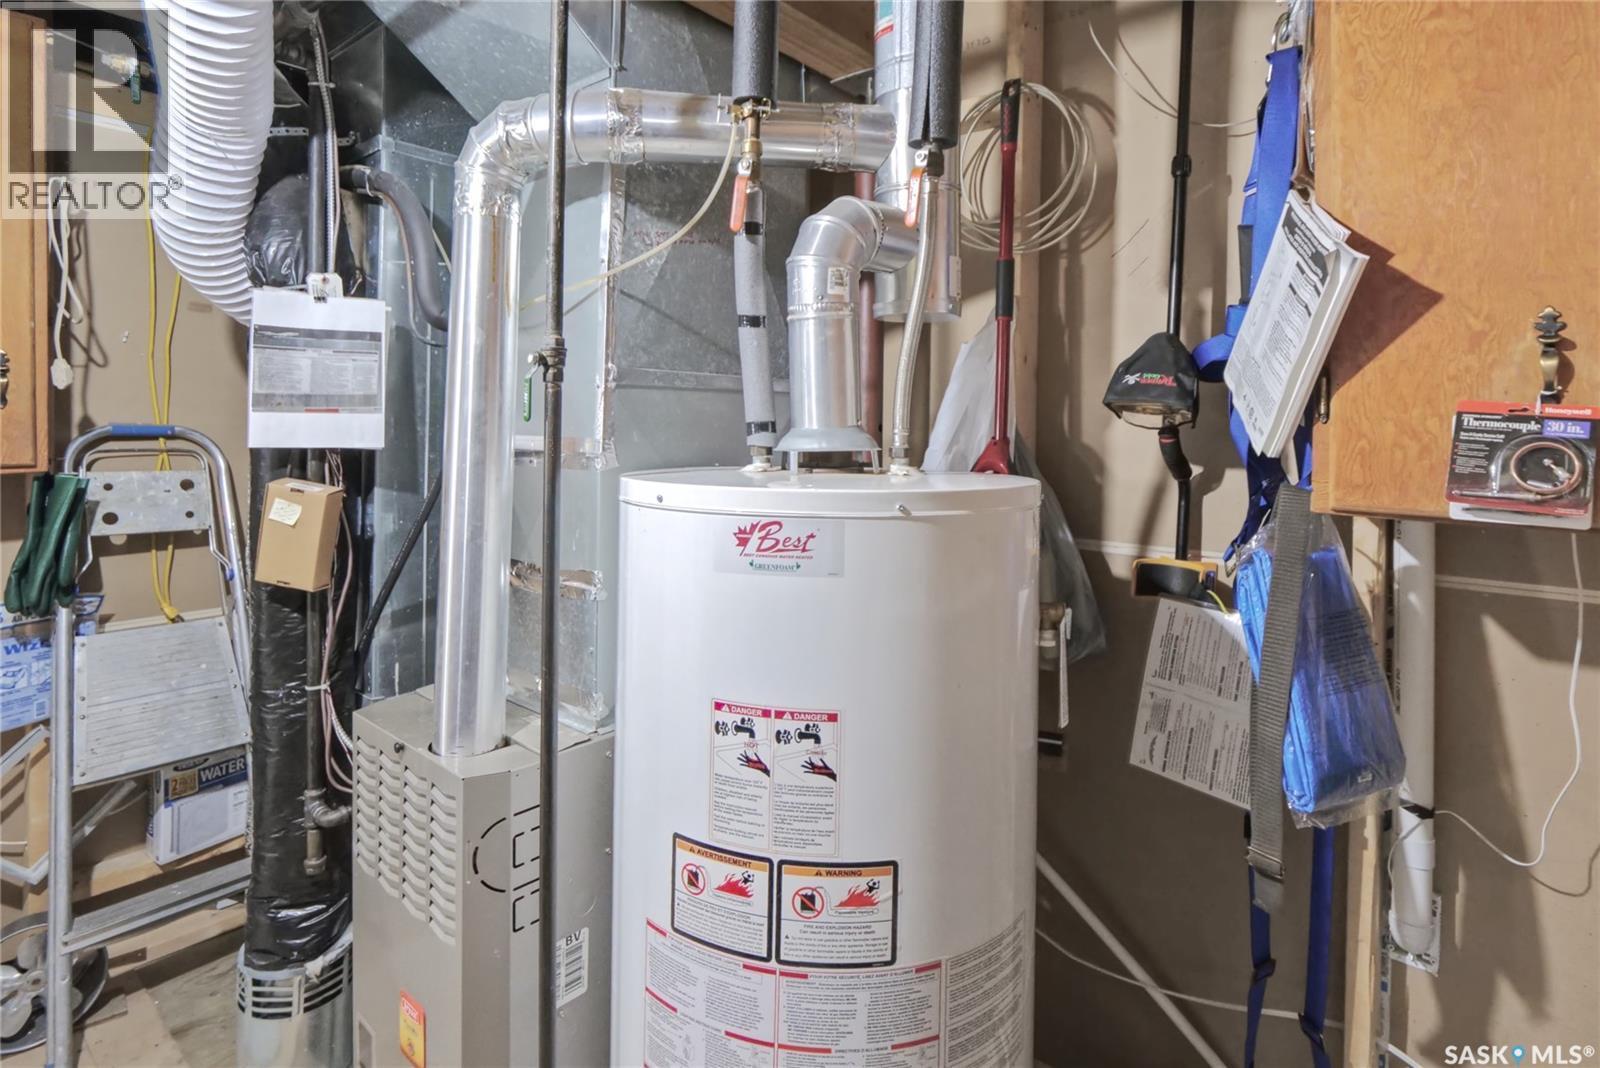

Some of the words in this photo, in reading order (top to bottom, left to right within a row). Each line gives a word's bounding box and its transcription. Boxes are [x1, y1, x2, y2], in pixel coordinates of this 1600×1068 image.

[1544, 407, 1593, 416] Honeywell
[1461, 416, 1541, 432] Thermocouple
[1546, 421, 1565, 434] 30
[1566, 422, 1585, 434] in.
[755, 520, 817, 553] Best
[731, 705, 763, 717] DANGER
[793, 712, 829, 721] DANGER
[200, 757, 246, 782] WATER
[697, 848, 753, 868] AVERTISSEMENT
[825, 869, 863, 877] WARNING
